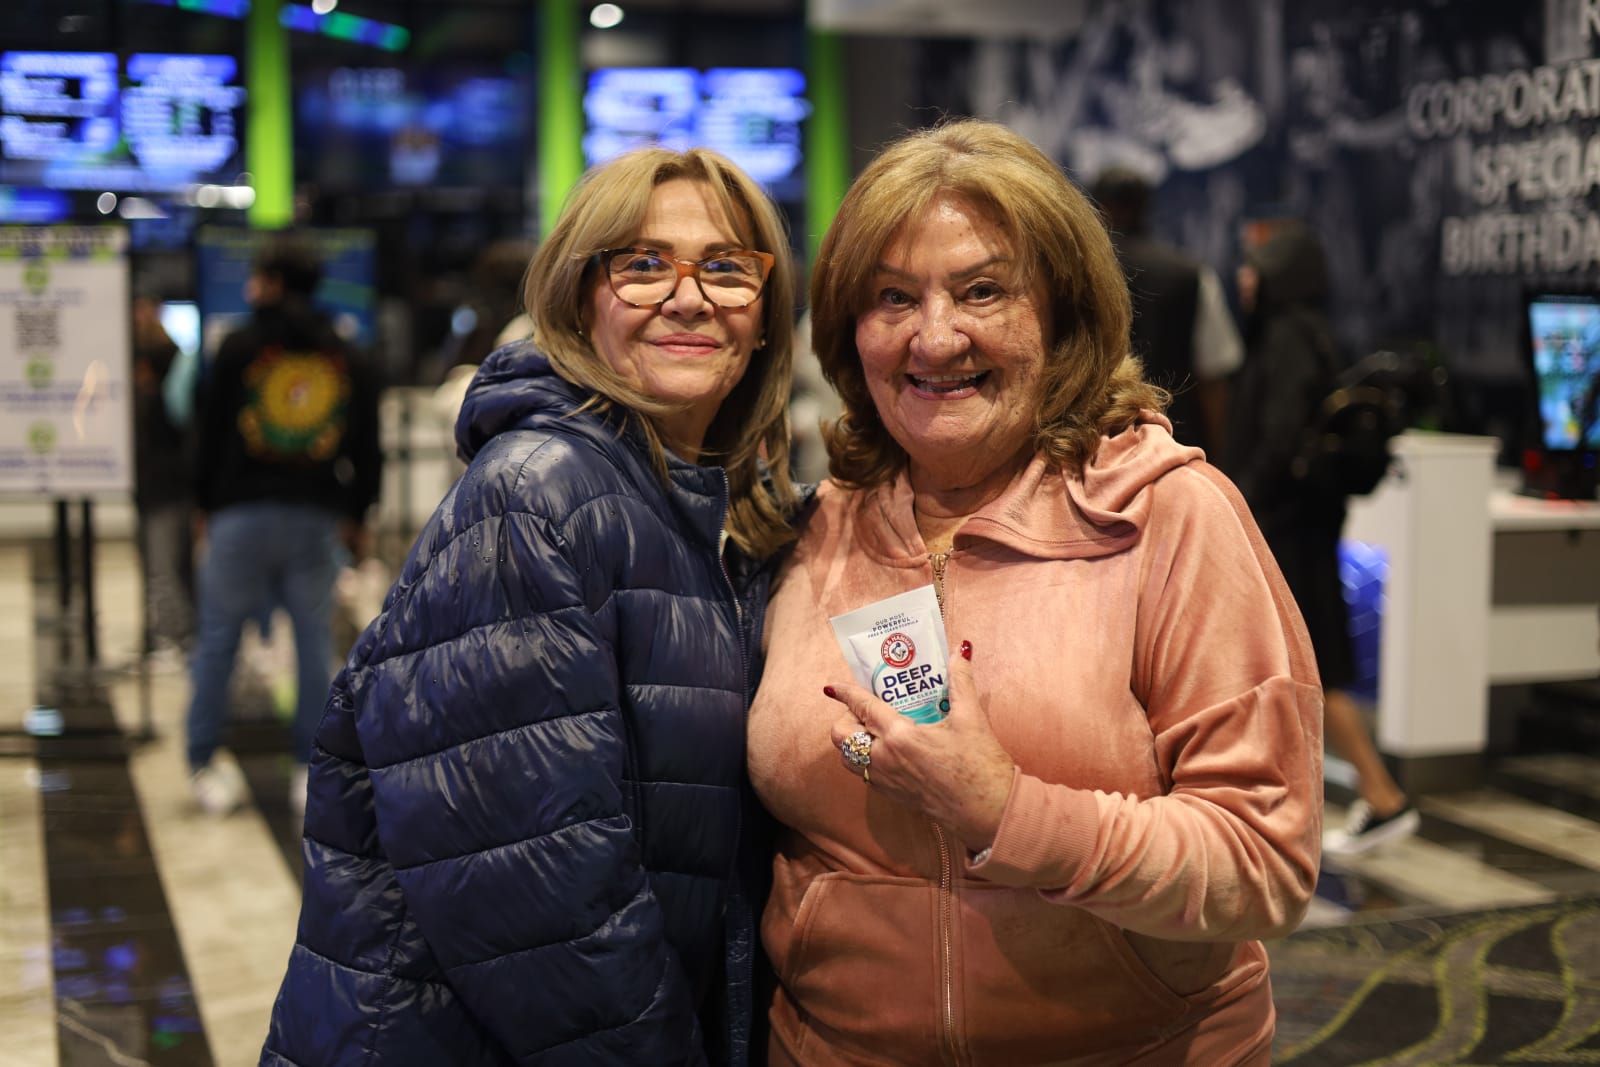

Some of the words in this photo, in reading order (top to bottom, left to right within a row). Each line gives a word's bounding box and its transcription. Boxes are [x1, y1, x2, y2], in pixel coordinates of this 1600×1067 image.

[872, 616, 911, 632] POWERFUL
[875, 618, 888, 626] OUR
[889, 612, 905, 621] MOST
[883, 663, 932, 688] DEEP
[881, 673, 944, 703] CLEAN
[916, 689, 938, 700] CLEAN
